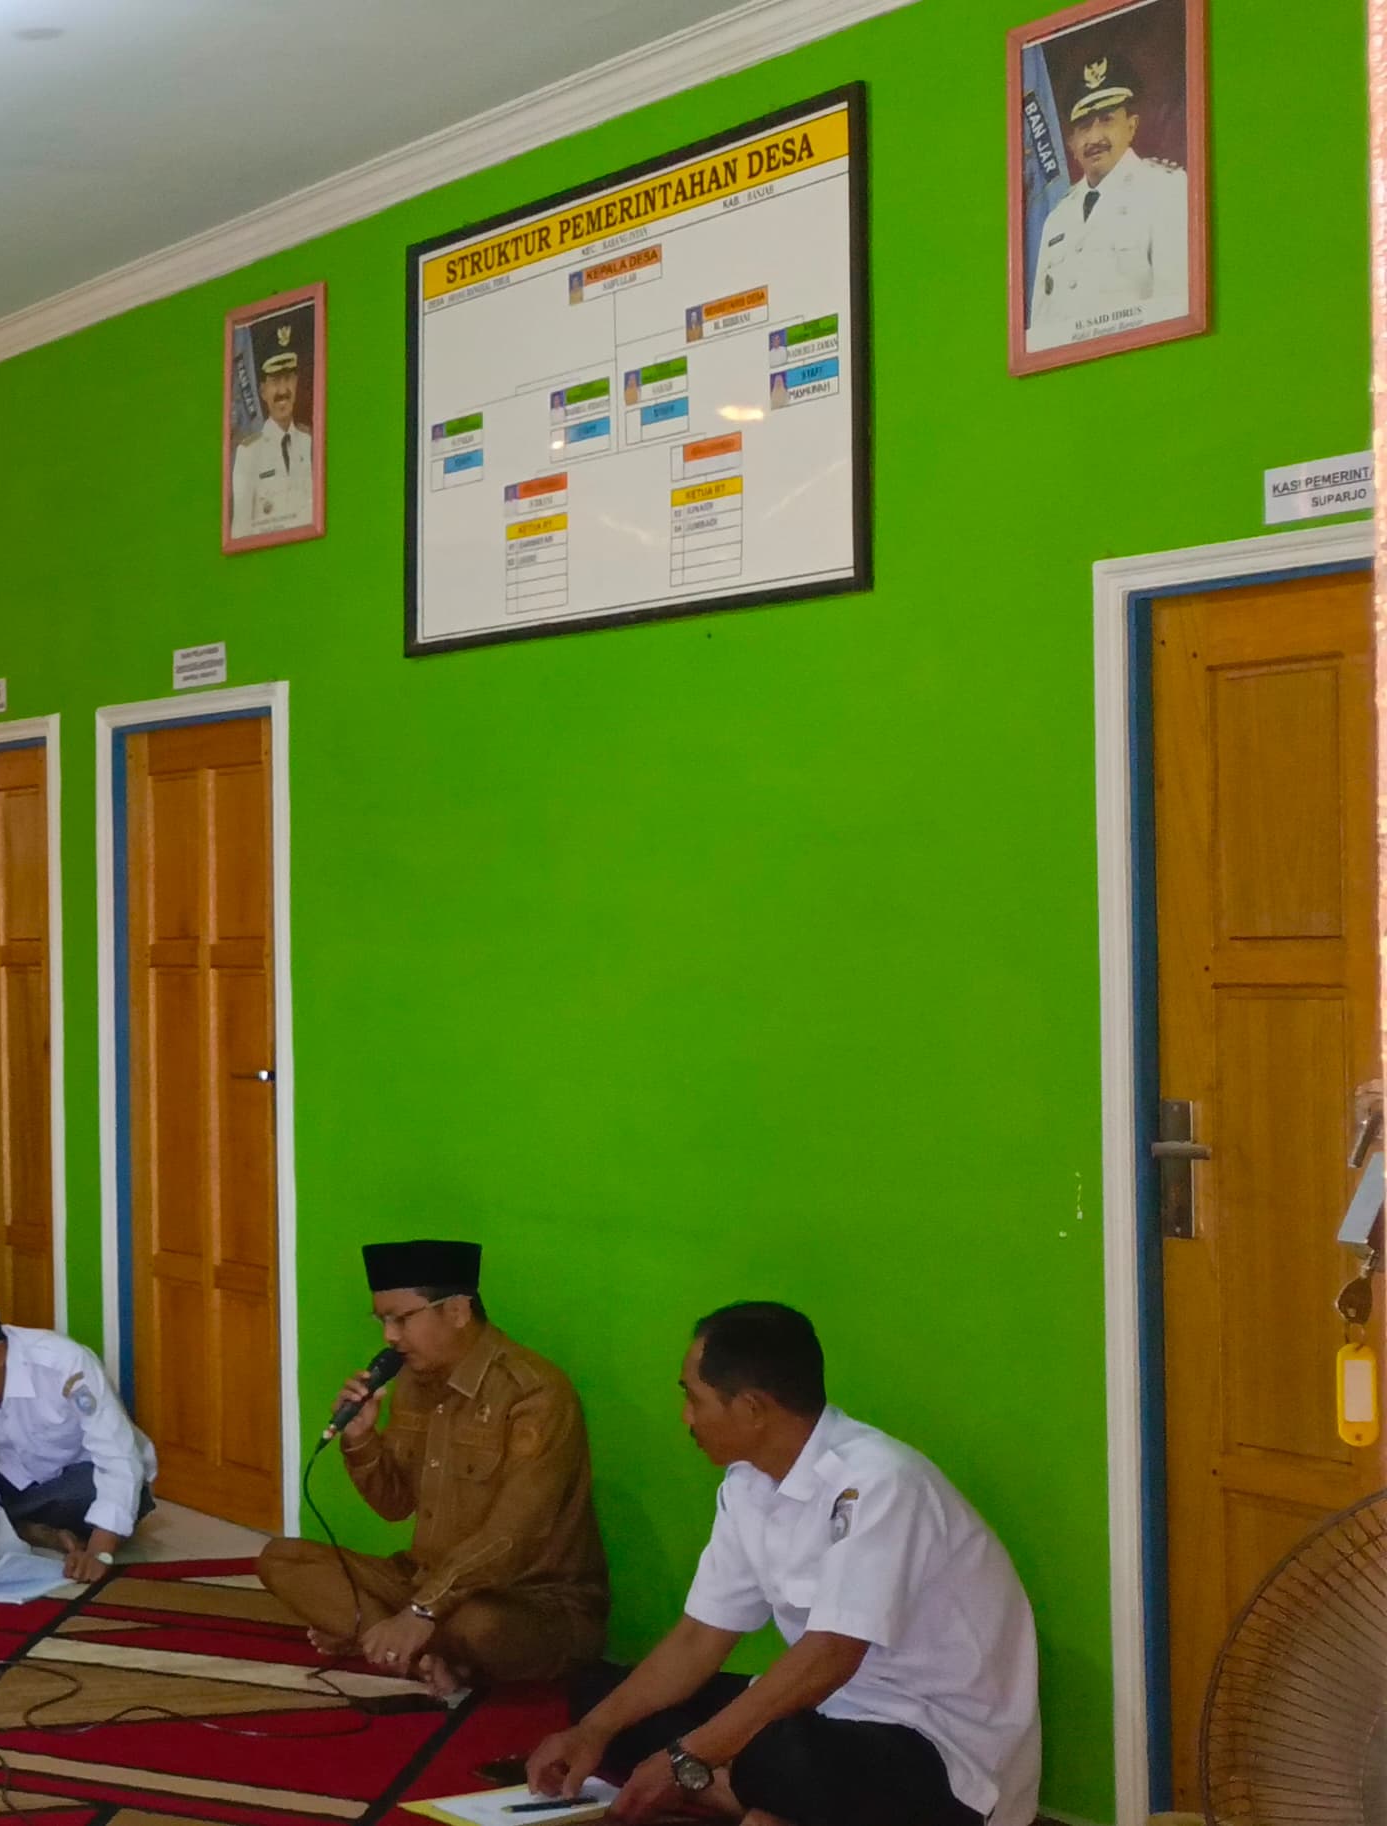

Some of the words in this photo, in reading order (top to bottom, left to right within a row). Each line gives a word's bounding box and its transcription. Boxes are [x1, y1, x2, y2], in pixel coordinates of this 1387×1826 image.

[446, 225, 551, 284] STRUKTUR
[559, 157, 738, 245] PEMERINTAHAN
[747, 132, 815, 180] DESA
[1272, 480, 1302, 495] KASI
[1311, 488, 1367, 507] SUPARJO
